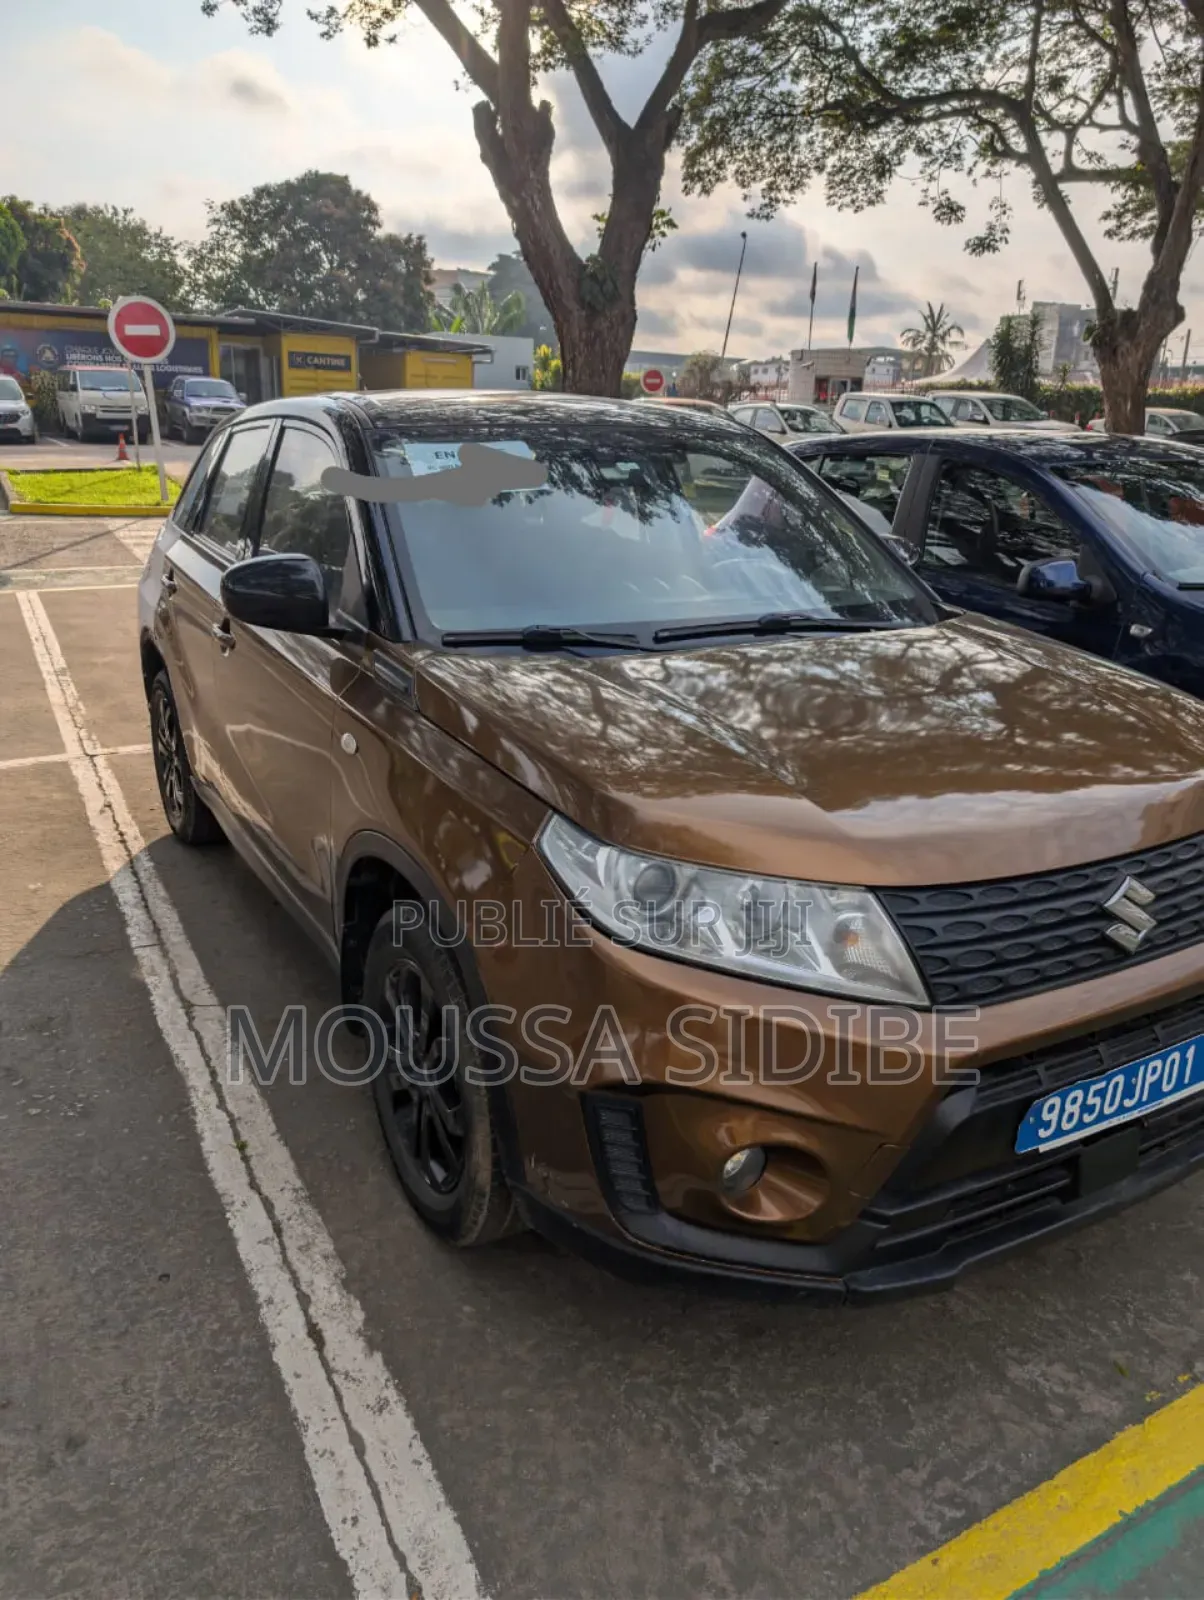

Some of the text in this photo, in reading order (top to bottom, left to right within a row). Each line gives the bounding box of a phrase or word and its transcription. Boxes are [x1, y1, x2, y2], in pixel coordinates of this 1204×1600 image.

[307, 355, 345, 367] CANTINE
[435, 451, 456, 460] EN
[1038, 1044, 1196, 1138] 9850JP01
